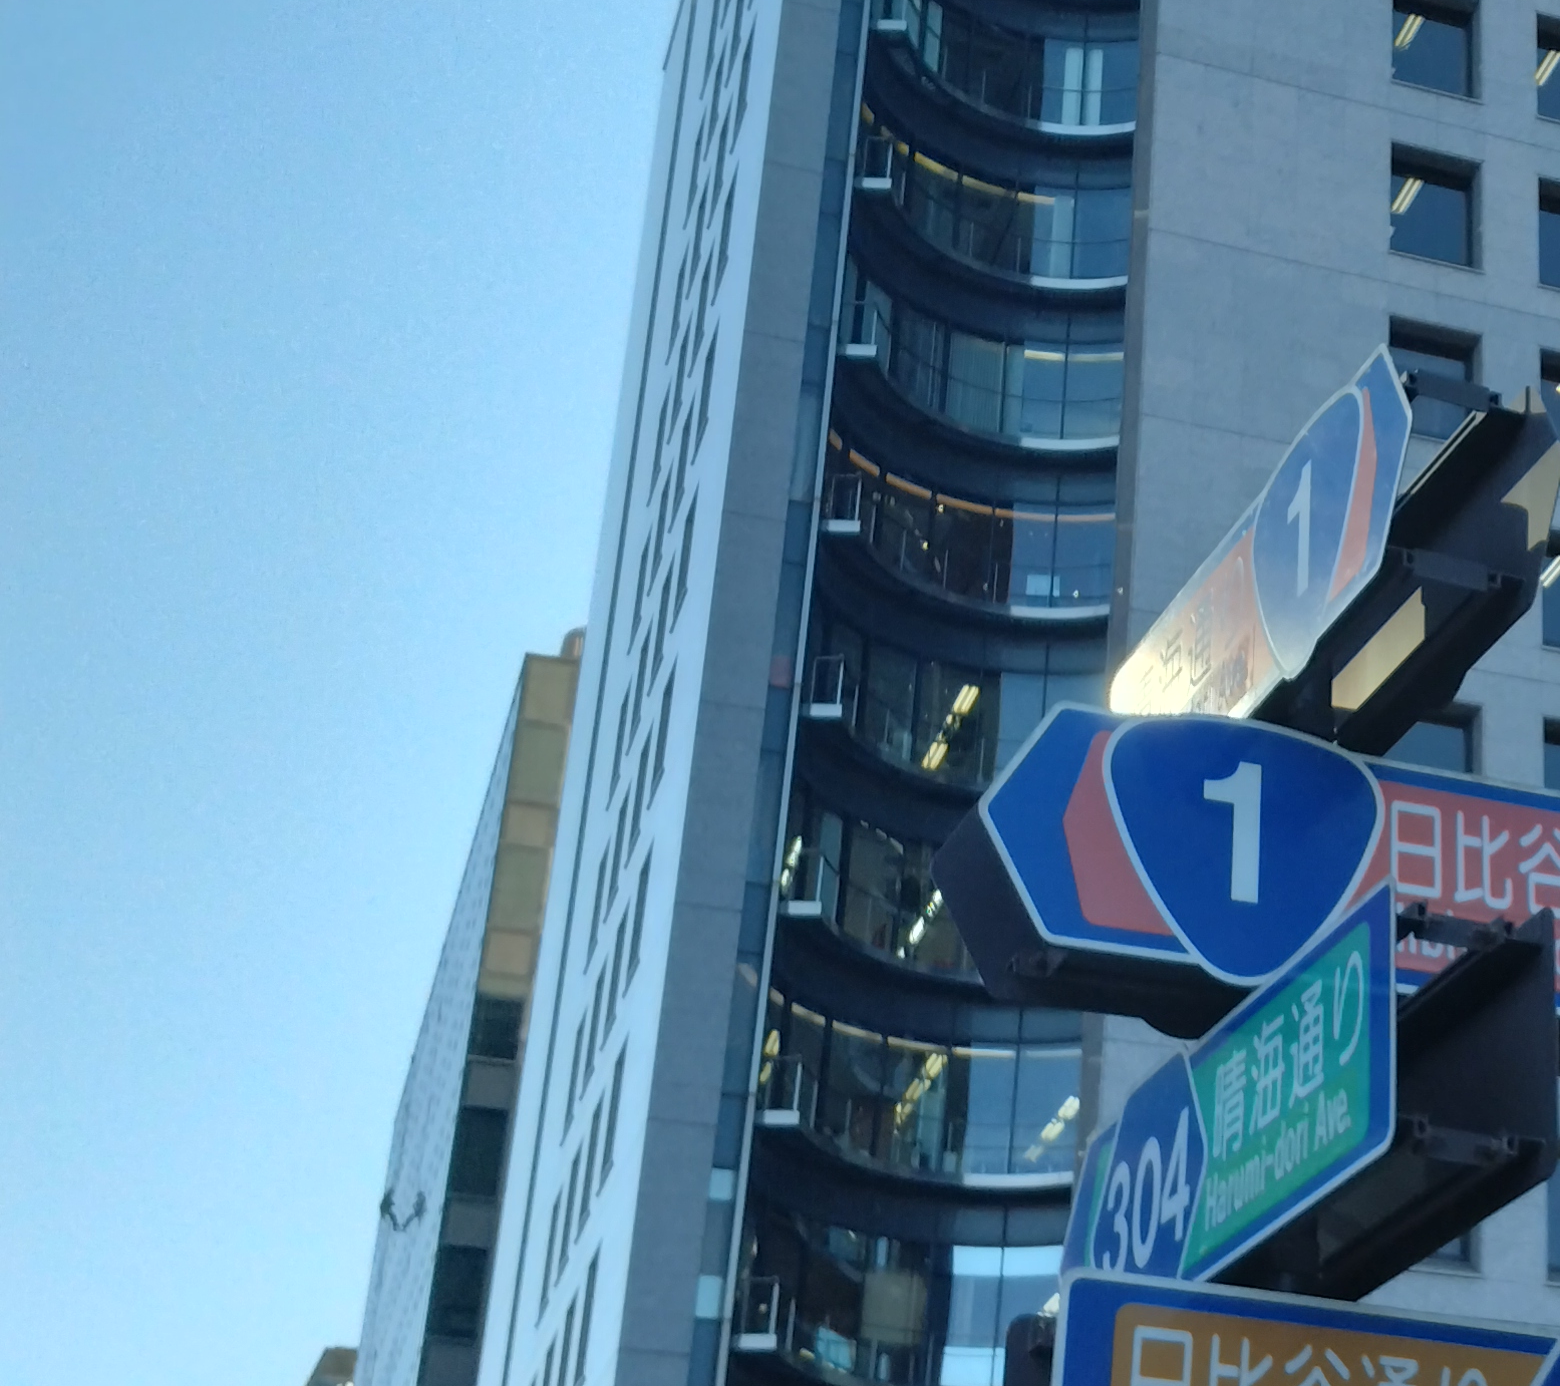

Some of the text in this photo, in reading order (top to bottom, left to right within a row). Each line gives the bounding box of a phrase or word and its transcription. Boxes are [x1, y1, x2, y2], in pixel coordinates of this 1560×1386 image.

[1287, 459, 1312, 597] 1
[1203, 762, 1262, 903] 1
[1212, 950, 1366, 1161] 晴海通り
[1103, 1106, 1191, 1272] 304
